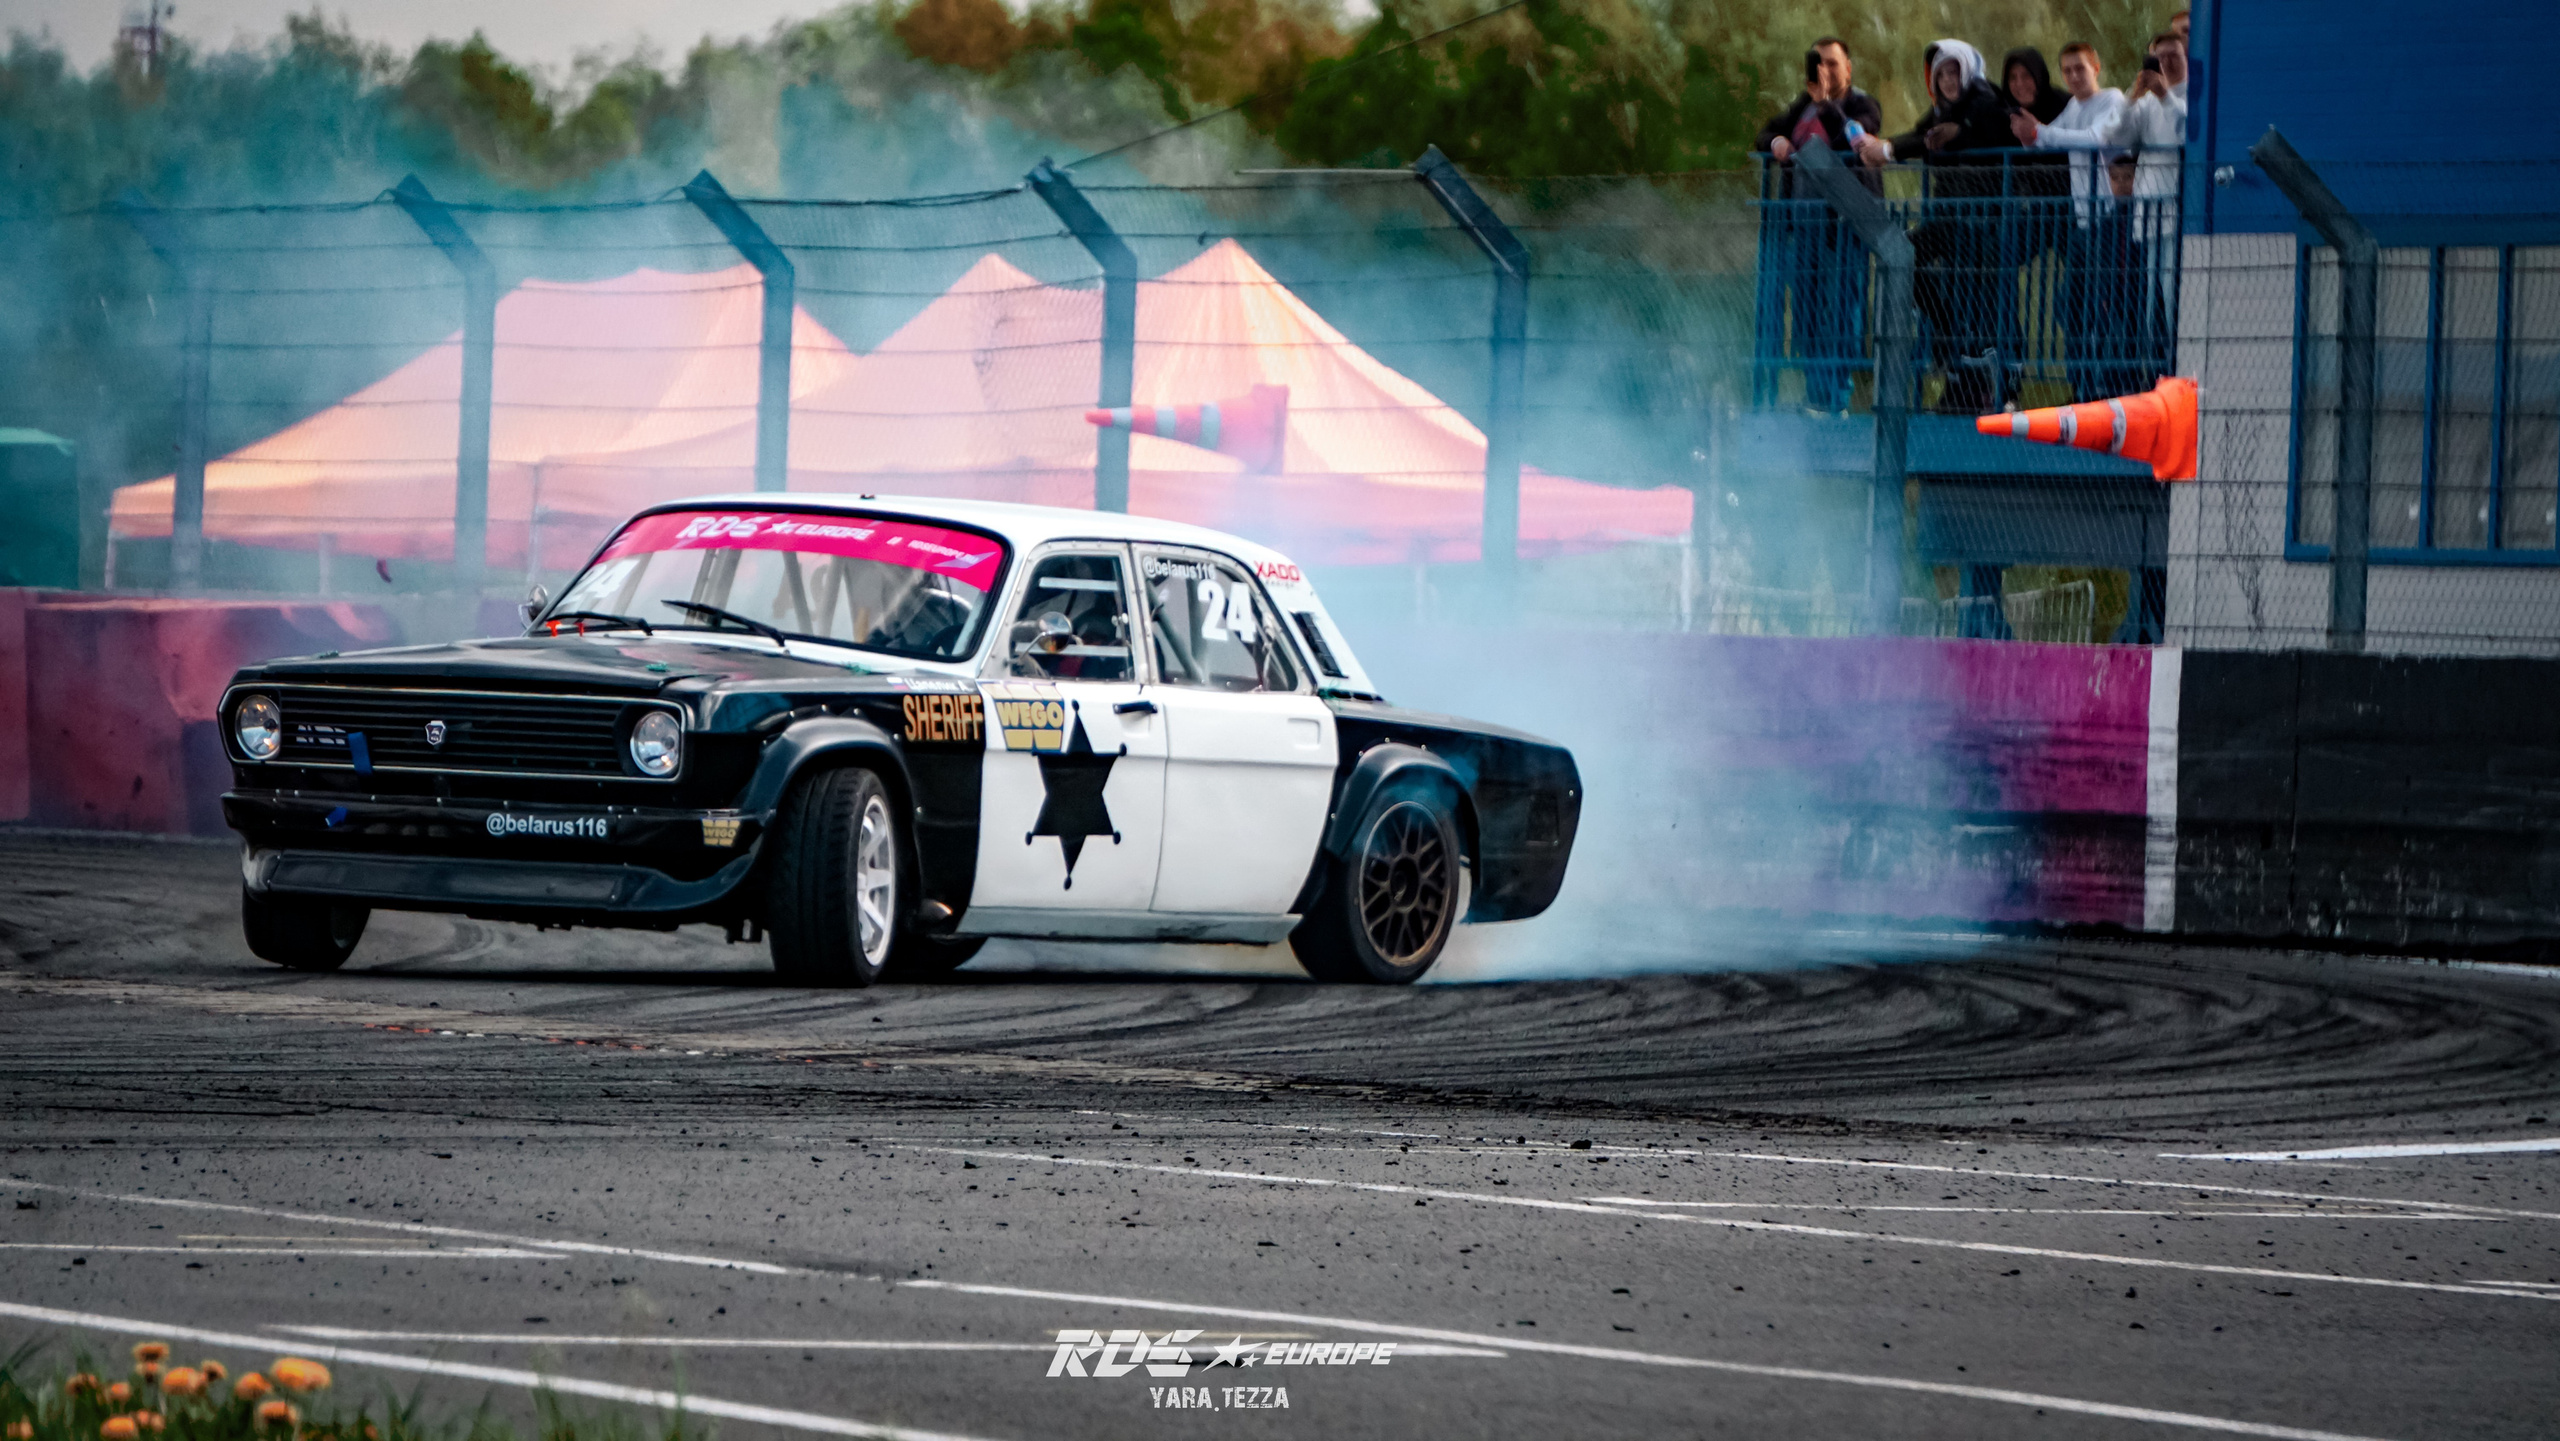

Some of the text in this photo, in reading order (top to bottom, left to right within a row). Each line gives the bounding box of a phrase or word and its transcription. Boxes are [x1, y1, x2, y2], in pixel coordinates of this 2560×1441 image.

[675, 516, 875, 541] RDS EUROPE
[1142, 555, 1216, 580] @belarus116
[1254, 560, 1300, 582] XADO
[1197, 579, 1257, 643] 24
[902, 694, 984, 742] SHERIFF
[996, 701, 1065, 729] WEGO
[486, 812, 607, 837] @belarus116
